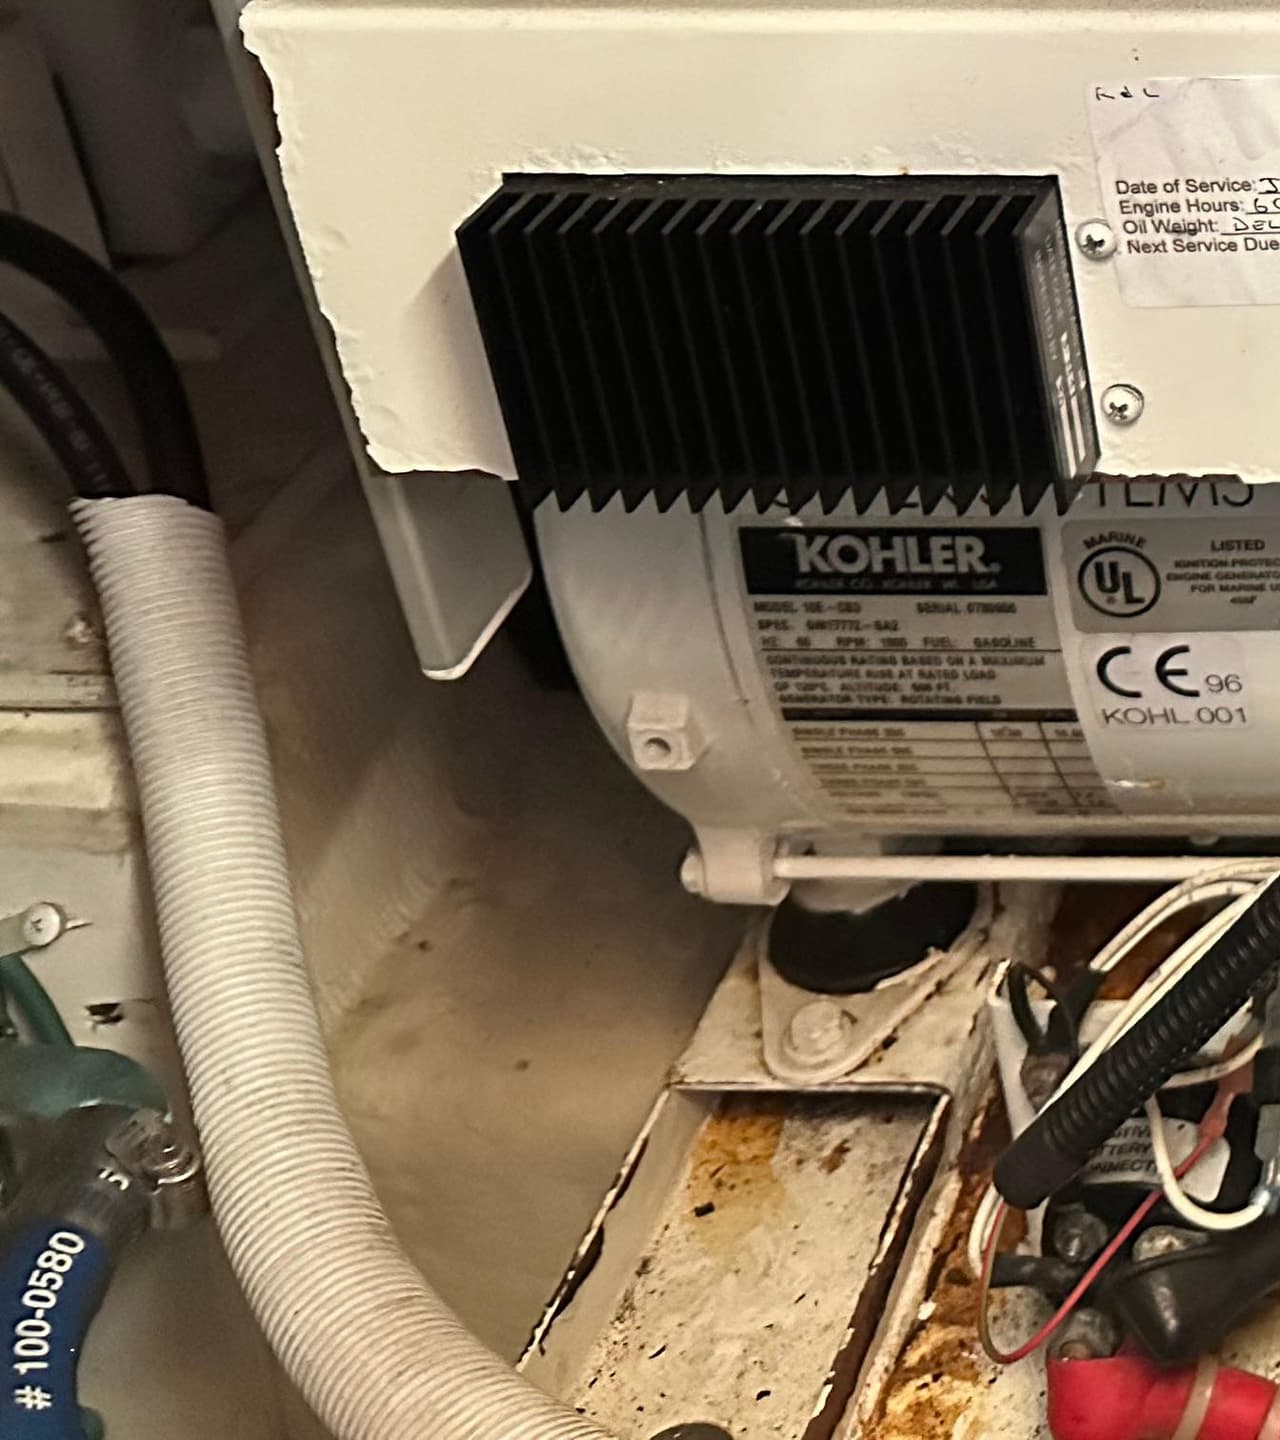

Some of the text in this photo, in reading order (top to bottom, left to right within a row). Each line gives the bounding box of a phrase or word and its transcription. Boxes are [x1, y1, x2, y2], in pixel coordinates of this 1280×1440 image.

[1115, 179, 1158, 195] Date
[1163, 178, 1180, 193] of
[1185, 178, 1257, 193] Service:
[1119, 199, 1181, 217] Engine
[1186, 198, 1244, 213] Hours:
[1122, 220, 1147, 235] Oil
[1151, 219, 1219, 237] Weight:
[1127, 239, 1168, 254] Next
[1172, 238, 1238, 253] Service
[1243, 237, 1280, 252] Due
[1082, 530, 1147, 549] MARINE
[1210, 539, 1266, 552] LISTED
[1094, 560, 1145, 604] UL
[1166, 571, 1212, 582] ENGINE
[1190, 583, 1216, 593] FOR
[1218, 582, 1267, 593] MARINE
[1204, 673, 1243, 693] 96
[1101, 706, 1247, 726] KOHL 001
[12, 1230, 86, 1411] # 100-0580
